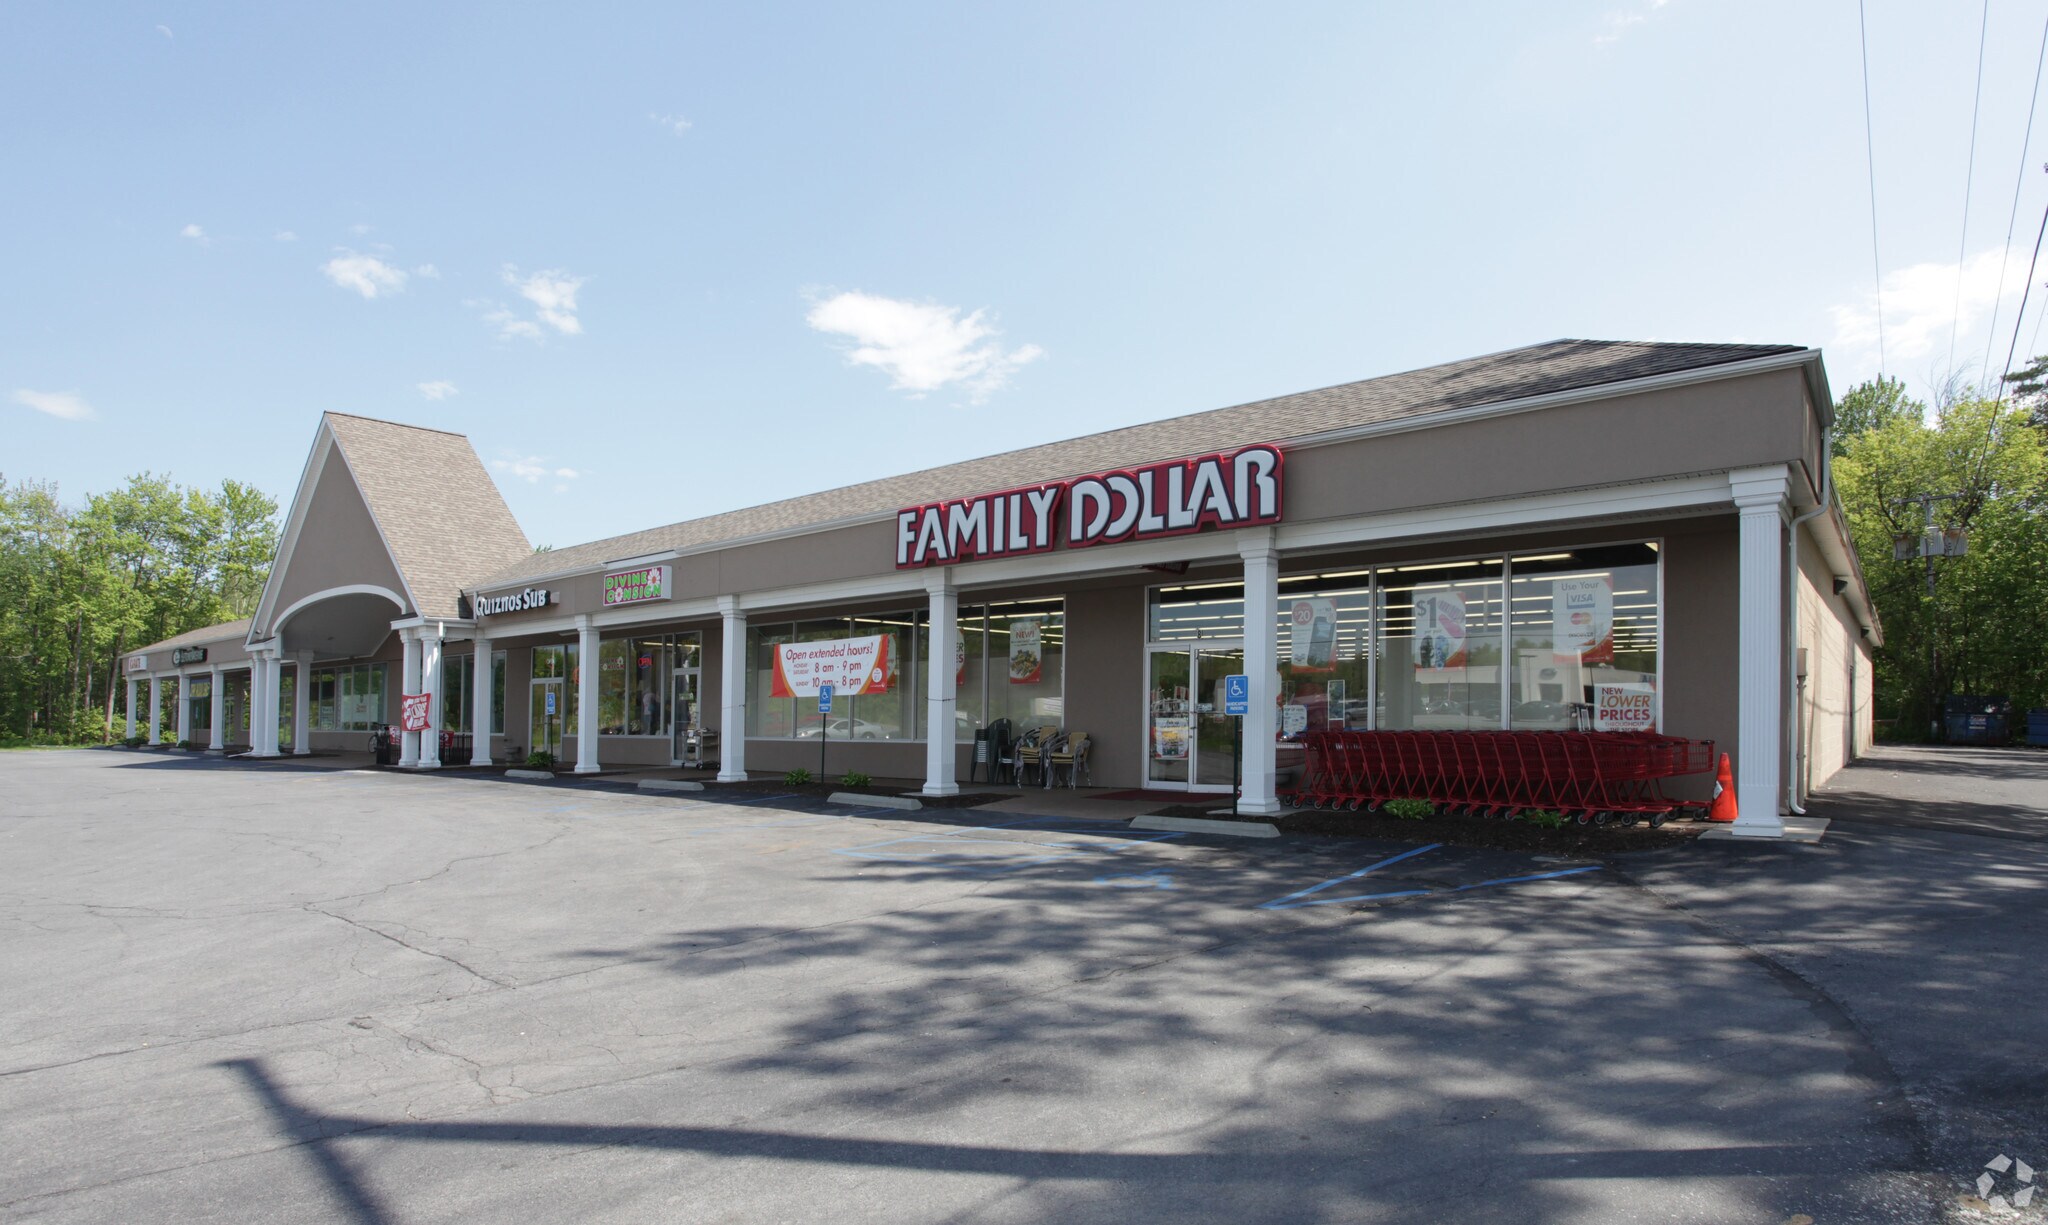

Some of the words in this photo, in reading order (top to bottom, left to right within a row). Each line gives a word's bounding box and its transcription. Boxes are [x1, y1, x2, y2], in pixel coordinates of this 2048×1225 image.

[897, 488, 1057, 565] FAMILY
[1070, 449, 1277, 542] DOLLAR
[605, 572, 648, 590] DIVINE
[1561, 583, 1577, 591] Use
[1580, 581, 1599, 590] Your
[1570, 593, 1593, 602] VISA
[1416, 597, 1437, 628] $1
[1015, 631, 1035, 639] NEW!
[786, 649, 807, 663] Open
[809, 644, 845, 659] extended
[847, 642, 874, 656] hours!
[814, 662, 820, 673] 8
[822, 664, 834, 673] am
[842, 660, 848, 672] 9
[849, 662, 862, 673] pm
[812, 677, 820, 688] 10
[842, 676, 847, 686] 8
[849, 677, 861, 689] pm
[1601, 687, 1623, 695] NEW
[1600, 695, 1651, 708] LOWER
[1600, 709, 1651, 721] PRICES
